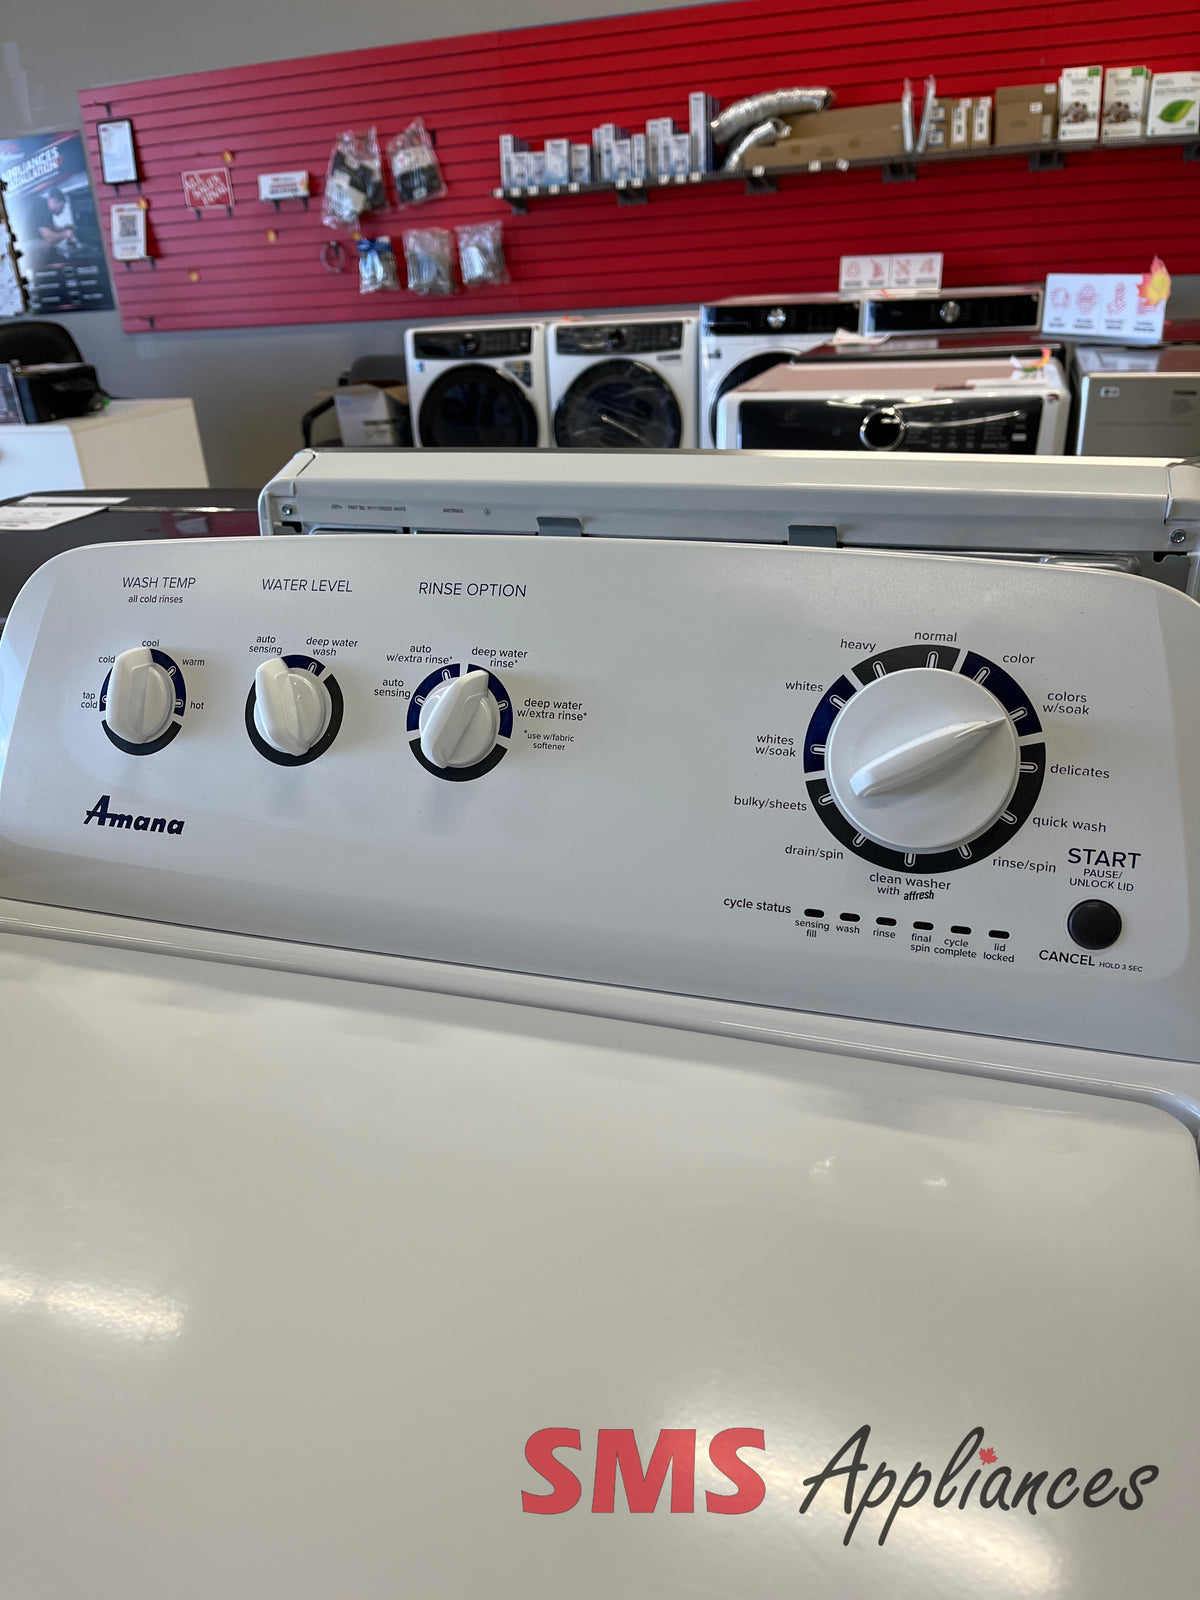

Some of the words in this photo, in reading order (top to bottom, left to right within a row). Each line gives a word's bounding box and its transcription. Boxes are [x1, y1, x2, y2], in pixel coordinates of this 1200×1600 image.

[123, 577, 158, 588] WASH
[163, 577, 196, 588] TEMP
[263, 579, 307, 591] WATER
[312, 580, 353, 592] LEVEL
[419, 582, 462, 595] RINSE
[467, 583, 526, 597] OPTION
[140, 595, 157, 603] cold
[159, 595, 183, 603] rinses
[306, 637, 329, 647] deep
[332, 639, 358, 647] water
[914, 632, 957, 642] normal
[142, 639, 159, 647] cool
[840, 638, 876, 652] heavy
[249, 645, 282, 655] sensing
[313, 648, 336, 656] wash
[410, 645, 431, 653] auto
[472, 647, 496, 658] deep
[500, 650, 528, 658] water
[387, 654, 422, 663] w/extra
[1003, 654, 1035, 663] color
[383, 679, 404, 687] auto
[786, 681, 823, 692] whites
[83, 692, 95, 701] tap
[374, 688, 410, 700] sensing
[1048, 691, 1086, 703] colors
[81, 700, 97, 708] cold
[191, 701, 204, 709] hot
[524, 698, 550, 710] deep
[553, 701, 582, 710] water
[1043, 703, 1089, 714] w/soak
[517, 709, 554, 719] w/extra
[543, 734, 574, 743] w/fabric
[757, 734, 793, 745] whites
[533, 742, 565, 750] softener
[756, 744, 796, 757] w/soak
[1051, 764, 1109, 778] delicates
[734, 796, 806, 811] bulky/sheets
[84, 795, 185, 834] Amana
[1033, 816, 1067, 828] quick
[1073, 821, 1106, 832] wash
[785, 844, 843, 859] drain/spin
[1068, 848, 1141, 868] START
[993, 857, 1056, 873] rinse/spin
[1084, 868, 1122, 879] PAUSE/
[869, 872, 901, 886] clean
[906, 878, 951, 890] washer
[1069, 877, 1114, 889] UNLOCK
[1118, 882, 1134, 891] LID
[878, 886, 899, 895] with
[904, 890, 934, 900] affresh
[724, 898, 753, 908] cycle
[757, 901, 791, 913] status
[795, 920, 829, 932] sensing
[836, 926, 859, 934] wash
[807, 928, 816, 938] fill
[873, 929, 895, 938] rinse
[912, 933, 931, 942] final
[911, 944, 930, 952] spin
[943, 938, 969, 949] cycle
[994, 943, 1005, 951] lid
[933, 947, 977, 959] complete
[983, 950, 1014, 962] locked
[1039, 950, 1096, 966] CANCEL
